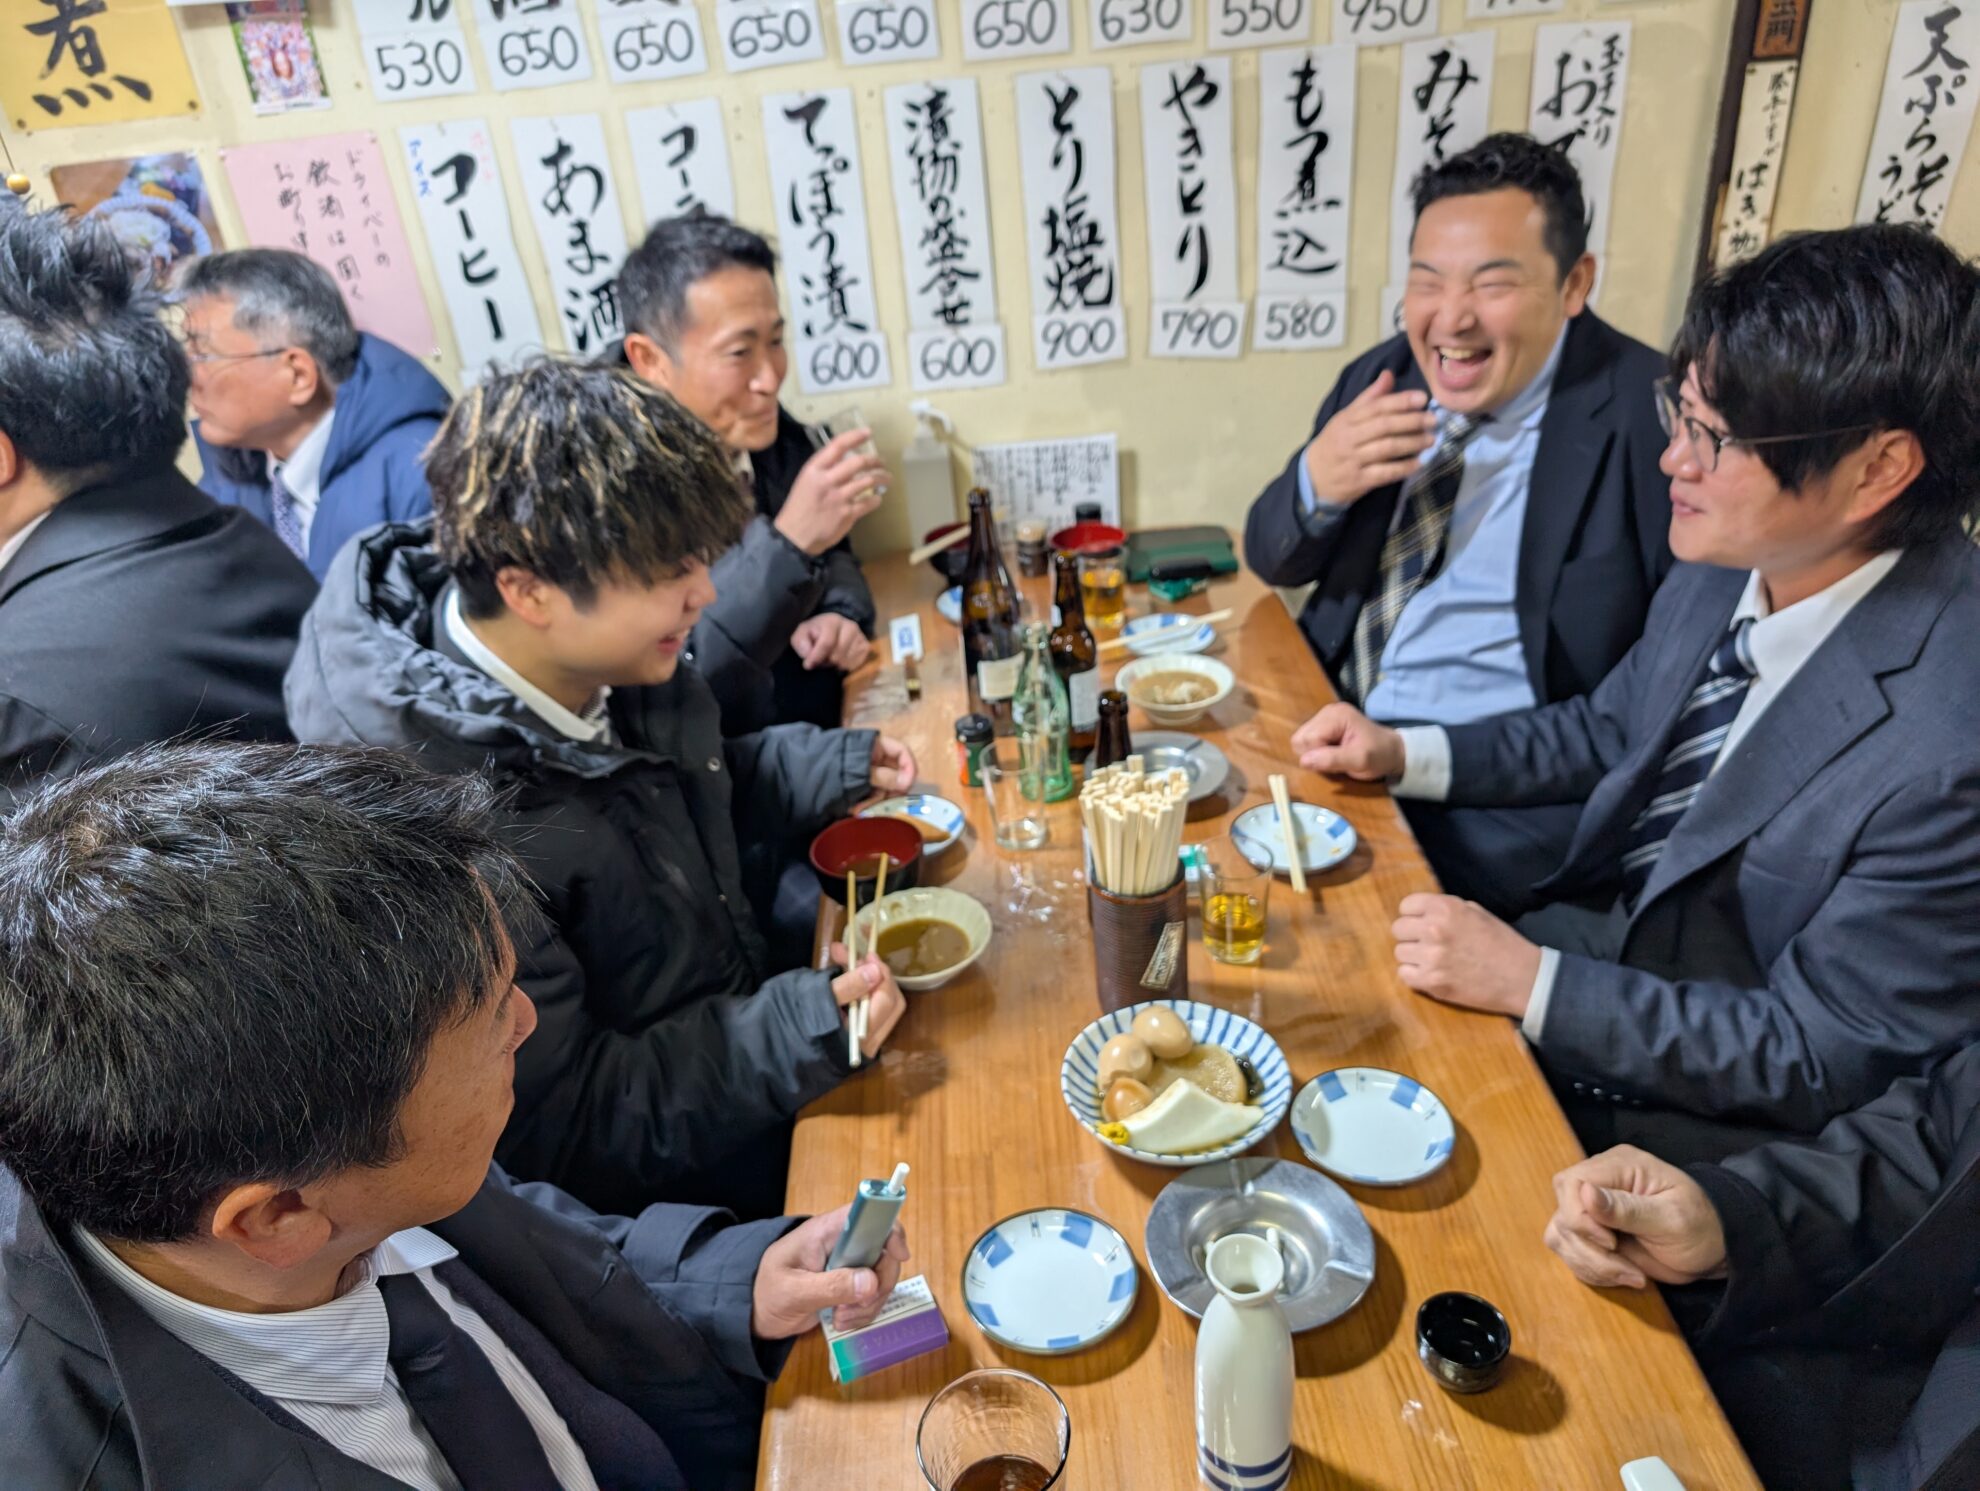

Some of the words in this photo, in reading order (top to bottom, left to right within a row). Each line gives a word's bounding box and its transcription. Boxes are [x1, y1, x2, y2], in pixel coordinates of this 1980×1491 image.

[729, 9, 811, 58] 650
[848, 6, 928, 54] 650
[974, 0, 1057, 49] 650
[1099, 0, 1181, 41] 630
[1220, 0, 1302, 36] 550
[374, 40, 462, 91] 530
[498, 25, 578, 76] 650
[614, 19, 694, 71] 650
[660, 124, 706, 212] コー
[1161, 64, 1219, 299] やきとり
[1042, 82, 1115, 315] とり塩焼
[431, 153, 505, 341] コーヒー
[541, 137, 620, 351] あま酒
[1041, 316, 1116, 361] 900
[1162, 309, 1238, 350] 790
[1264, 301, 1337, 341] 580
[810, 340, 880, 386] 600
[920, 336, 996, 382] 600
